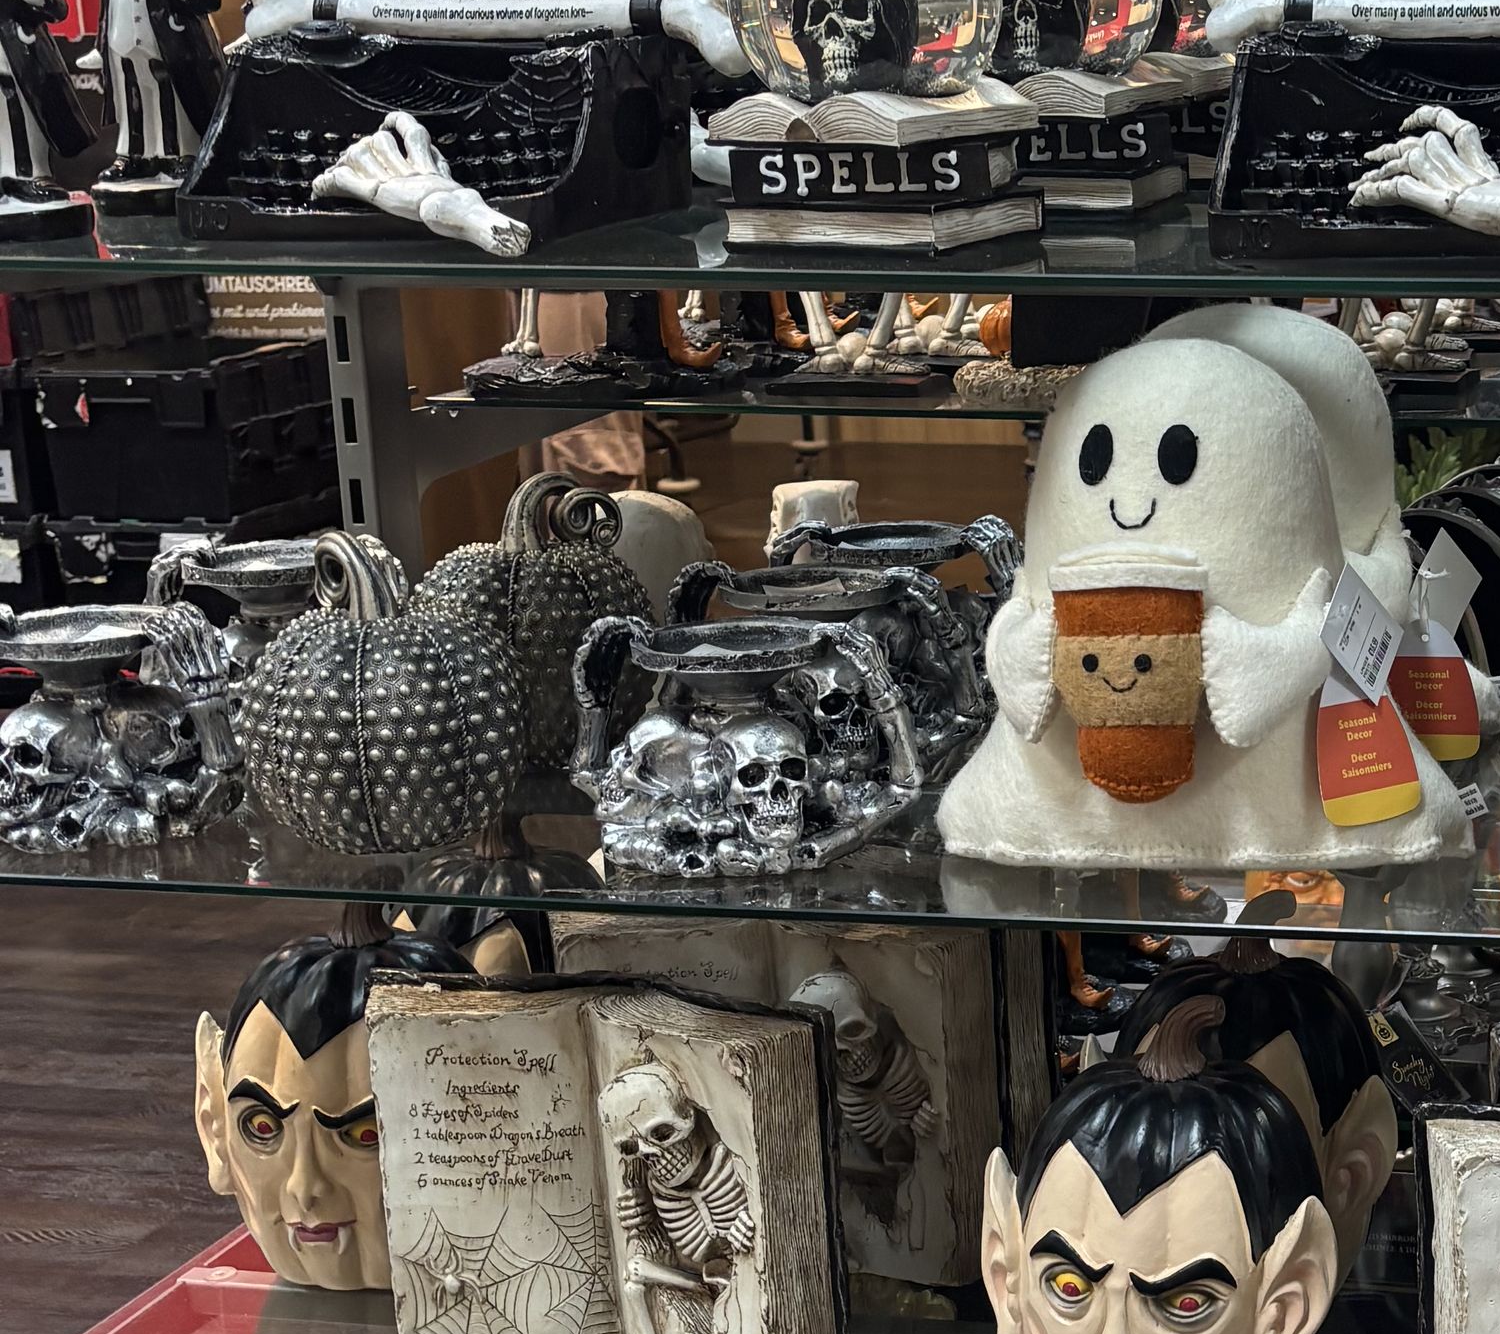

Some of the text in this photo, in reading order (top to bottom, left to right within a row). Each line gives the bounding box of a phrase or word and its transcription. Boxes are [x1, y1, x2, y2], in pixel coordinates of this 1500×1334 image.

[372, 5, 393, 18] Over
[393, 8, 415, 21] many
[416, 10, 422, 18] a
[423, 7, 449, 21] quaint
[449, 7, 464, 19] and
[465, 8, 495, 19] curious
[495, 7, 524, 19] volume
[525, 6, 534, 19] of
[534, 6, 570, 22] forgotten
[1351, 3, 1373, 17] Over
[1374, 6, 1399, 21] many
[1400, 7, 1406, 17] a
[1407, 5, 1436, 19] quaint
[1437, 4, 1454, 17] and
[1455, 4, 1488, 17] curious
[1014, 121, 1147, 163] ELLS
[758, 149, 963, 197] SPELLS
[1408, 669, 1450, 679] Seasonal
[1415, 681, 1444, 690] Decor
[1338, 712, 1377, 730] Seasonal
[1346, 729, 1373, 742] Decor
[1341, 761, 1393, 779] Saisonniers
[700, 960, 739, 983] Spell
[425, 1044, 557, 1073] Protection Spell
[446, 1079, 520, 1099] Ingredients
[409, 1101, 520, 1124] 8 Eyes of Spiders
[425, 1127, 487, 1144] tablespoon
[490, 1123, 541, 1146] Dragon's
[541, 1121, 586, 1140] Breath
[414, 1144, 573, 1168] 2 teaspoons of Grave Dust
[432, 1174, 477, 1188] ounces
[475, 1173, 487, 1190] of
[485, 1170, 527, 1187] Snake
[528, 1168, 573, 1184] Venom
